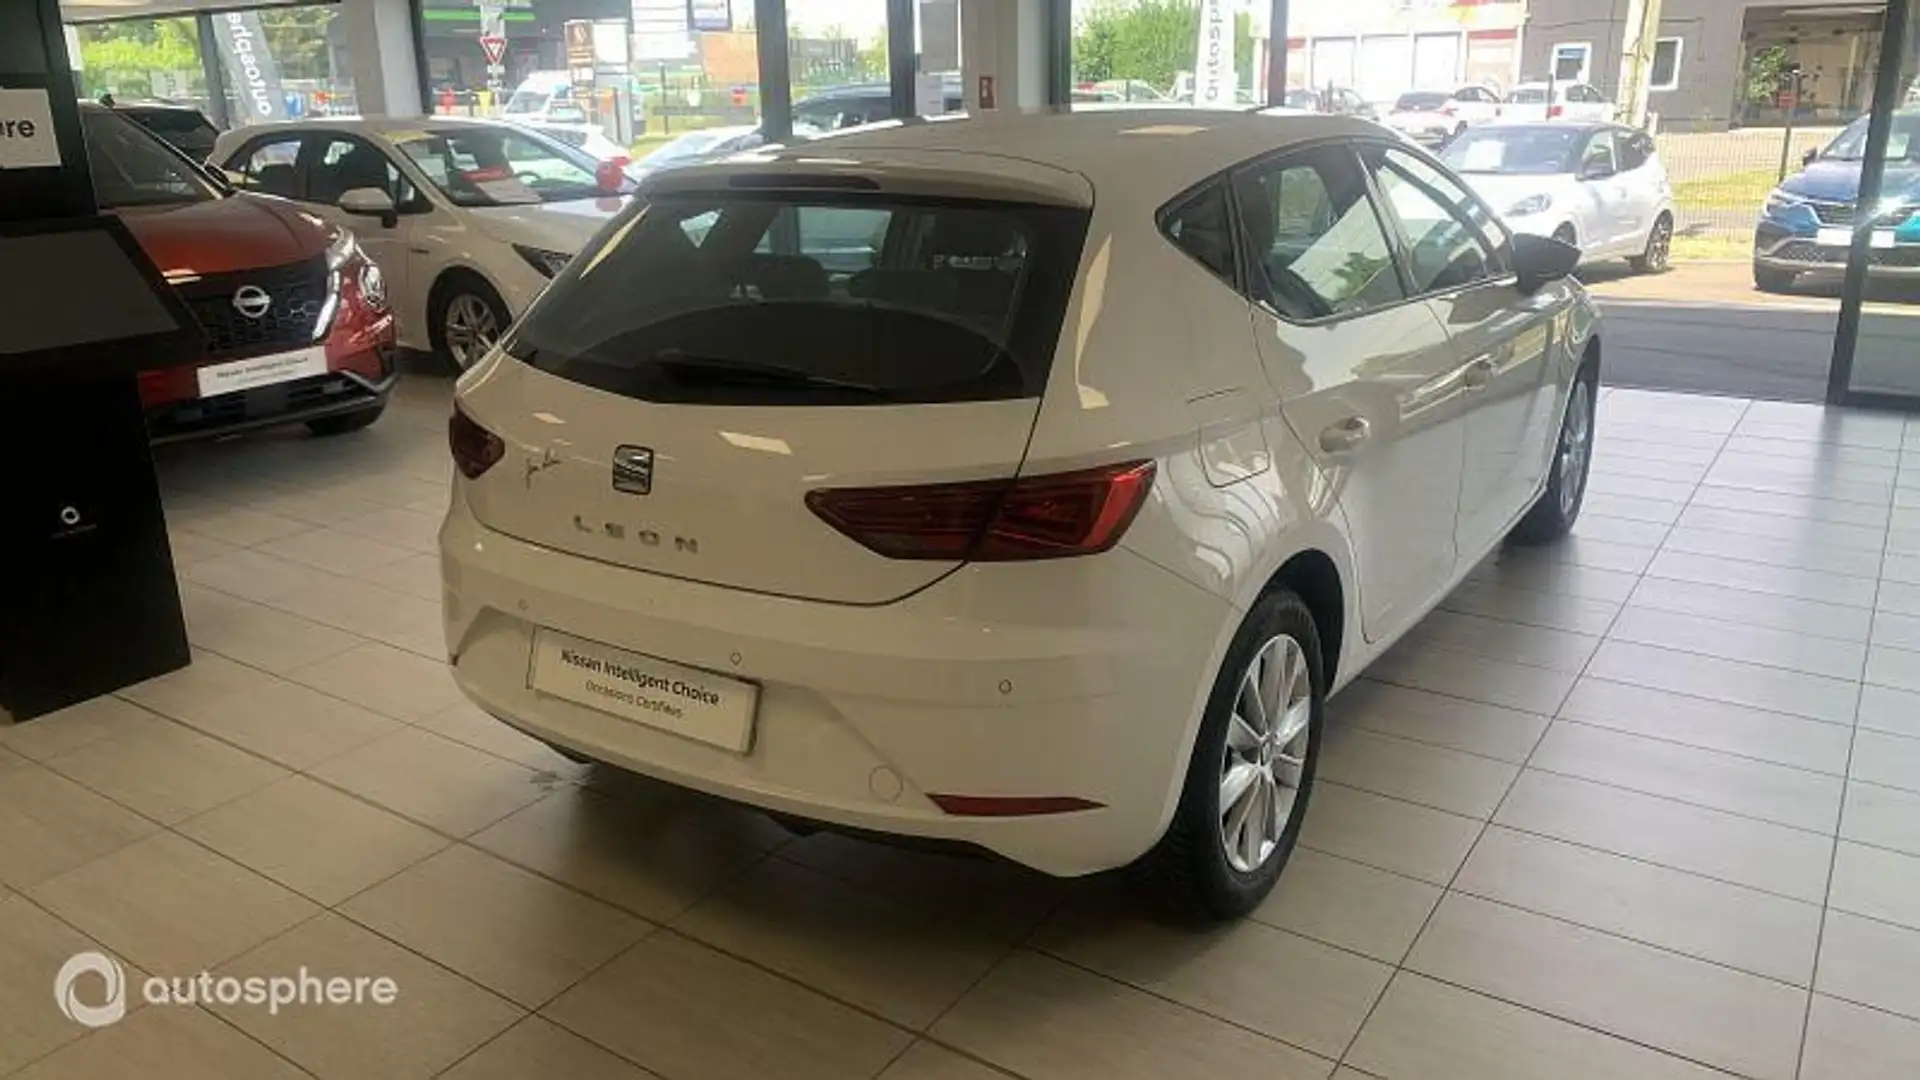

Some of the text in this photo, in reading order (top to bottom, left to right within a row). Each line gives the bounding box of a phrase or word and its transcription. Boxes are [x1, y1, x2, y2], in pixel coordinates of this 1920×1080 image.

[573, 514, 698, 554] LEON
[559, 648, 720, 706] Nissan Intelligent Choice
